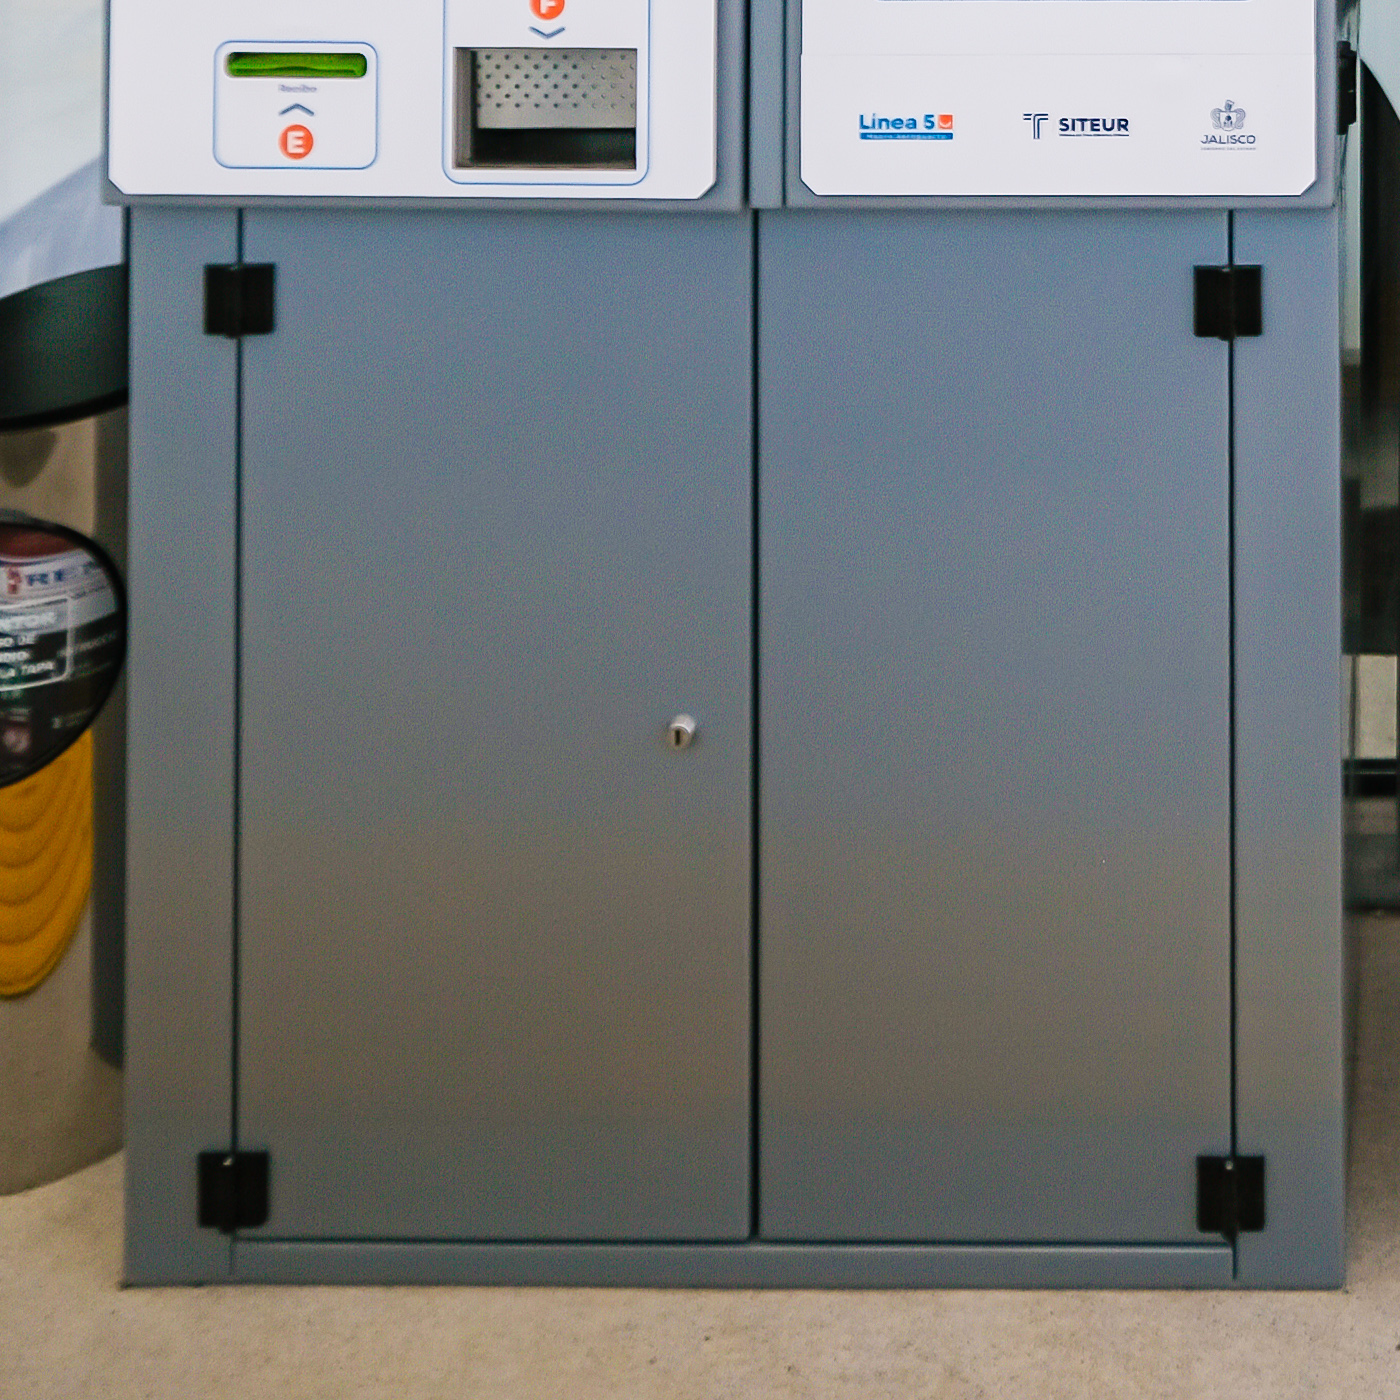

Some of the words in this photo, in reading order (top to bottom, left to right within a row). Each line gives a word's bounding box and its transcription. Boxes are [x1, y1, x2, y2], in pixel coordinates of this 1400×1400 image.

[924, 114, 935, 130] 5
[1059, 118, 1129, 132] SITEUR
[287, 131, 305, 152] E
[1201, 135, 1256, 144] JALISCO
